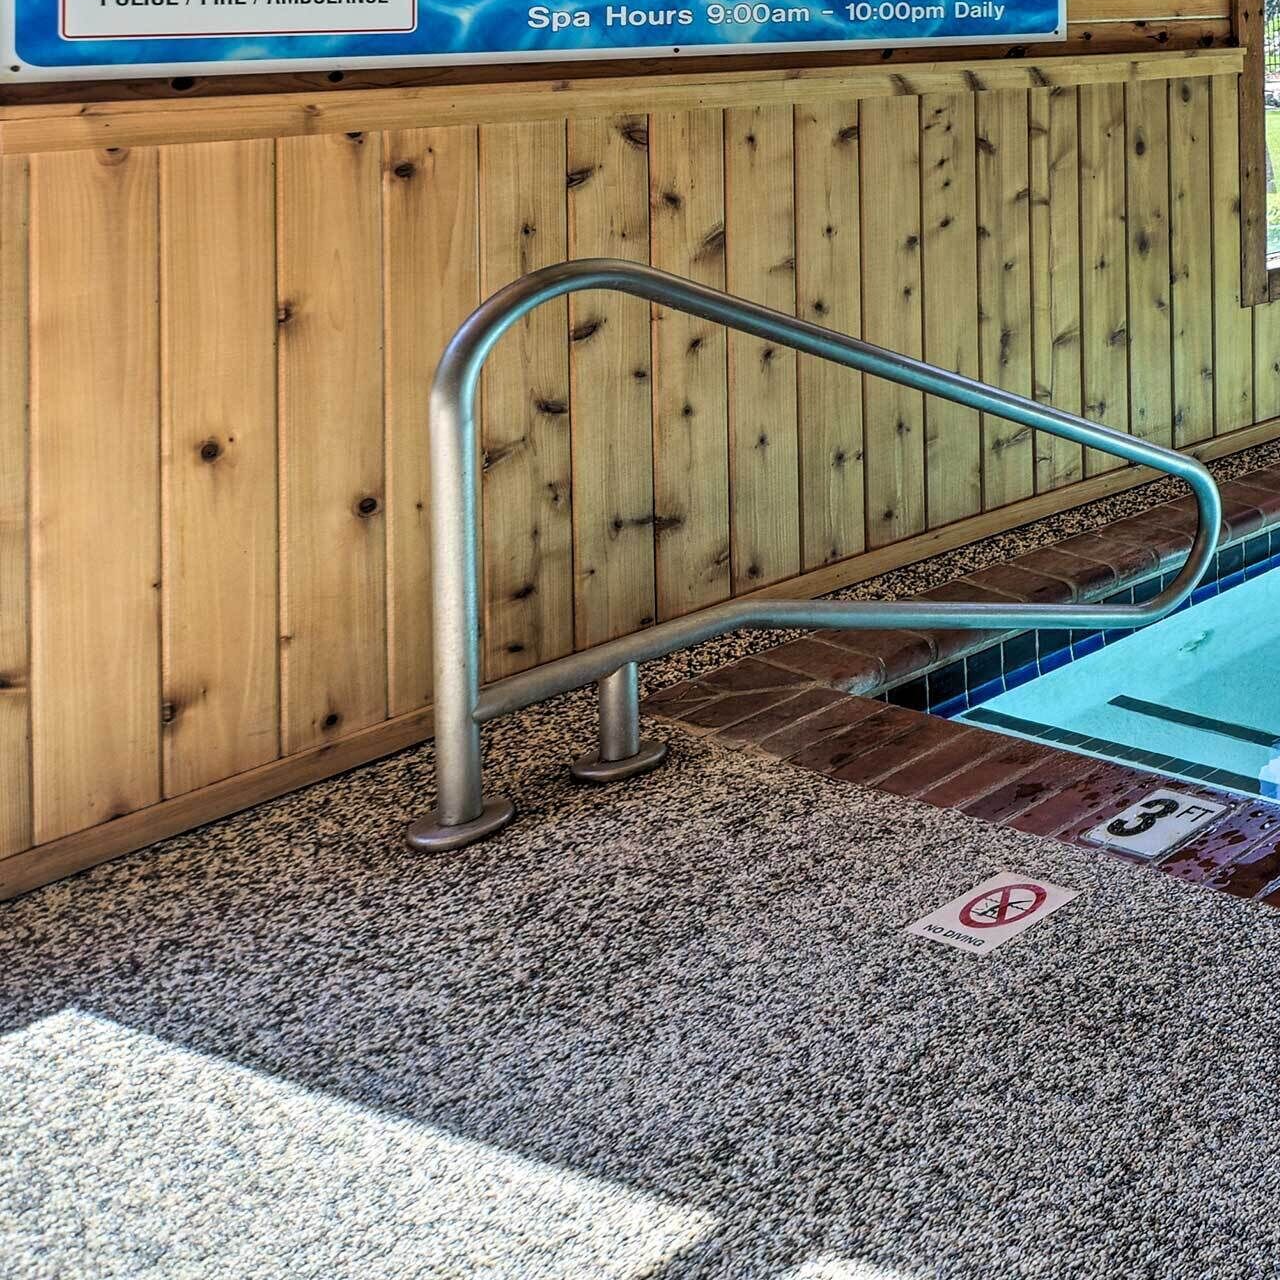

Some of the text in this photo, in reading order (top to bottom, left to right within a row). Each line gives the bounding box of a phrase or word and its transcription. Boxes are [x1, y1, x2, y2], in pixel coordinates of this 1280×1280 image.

[528, 6, 590, 32] Spa
[606, 6, 693, 27] Hours
[706, 4, 810, 24] 9:00am
[845, 2, 945, 22] 10:00pm
[954, 1, 1004, 21] Daily
[1106, 798, 1216, 837] 3 FT
[922, 923, 985, 948] NO DIVING
